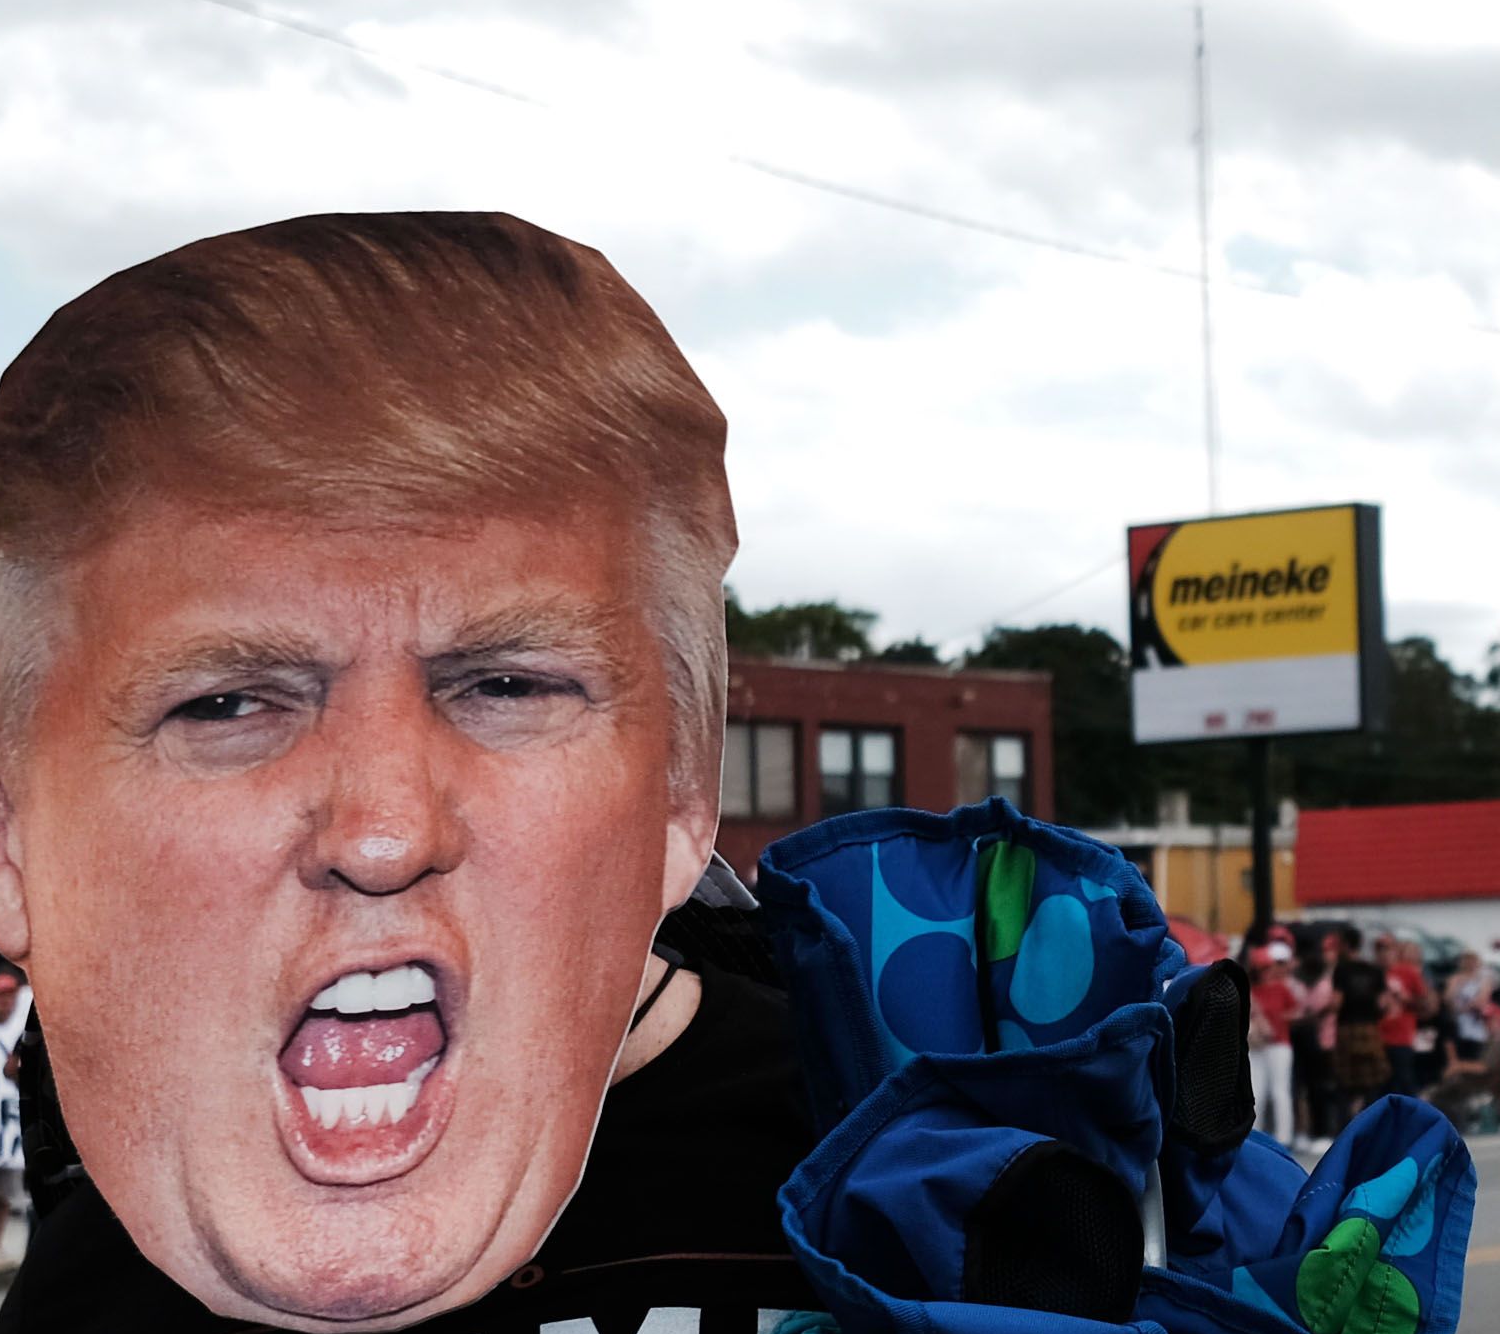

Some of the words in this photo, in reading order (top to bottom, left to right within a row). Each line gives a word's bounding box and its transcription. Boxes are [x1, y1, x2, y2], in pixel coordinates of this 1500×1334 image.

[1170, 556, 1331, 606] meineke
[1177, 614, 1206, 633] car
[1214, 609, 1255, 631] care
[1262, 604, 1326, 625] center
